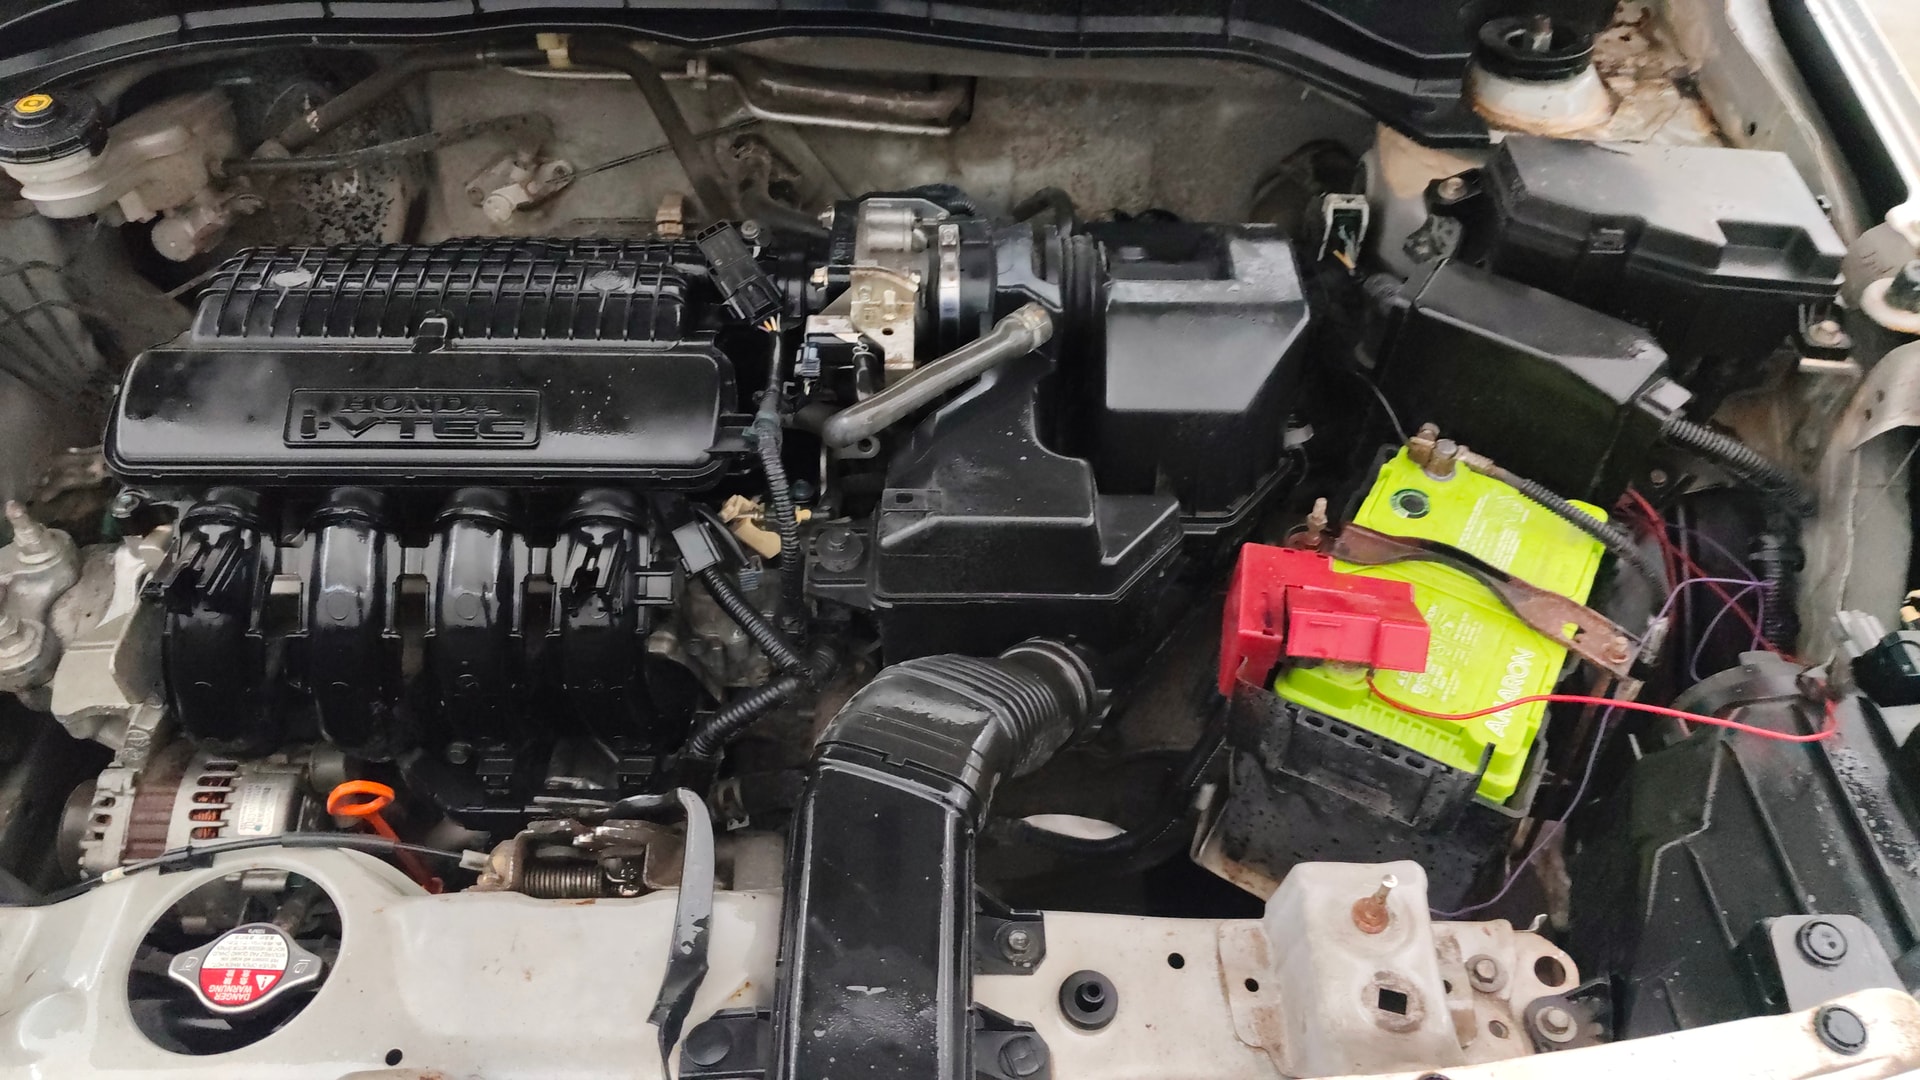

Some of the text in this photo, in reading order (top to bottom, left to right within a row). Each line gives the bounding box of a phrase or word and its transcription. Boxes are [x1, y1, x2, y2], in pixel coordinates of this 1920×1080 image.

[339, 396, 503, 416] HONDA
[300, 408, 527, 440] i-VTEC
[1484, 646, 1536, 738] AMARON
[208, 985, 252, 993] WARNUNG
[214, 992, 250, 1000] DANGER
